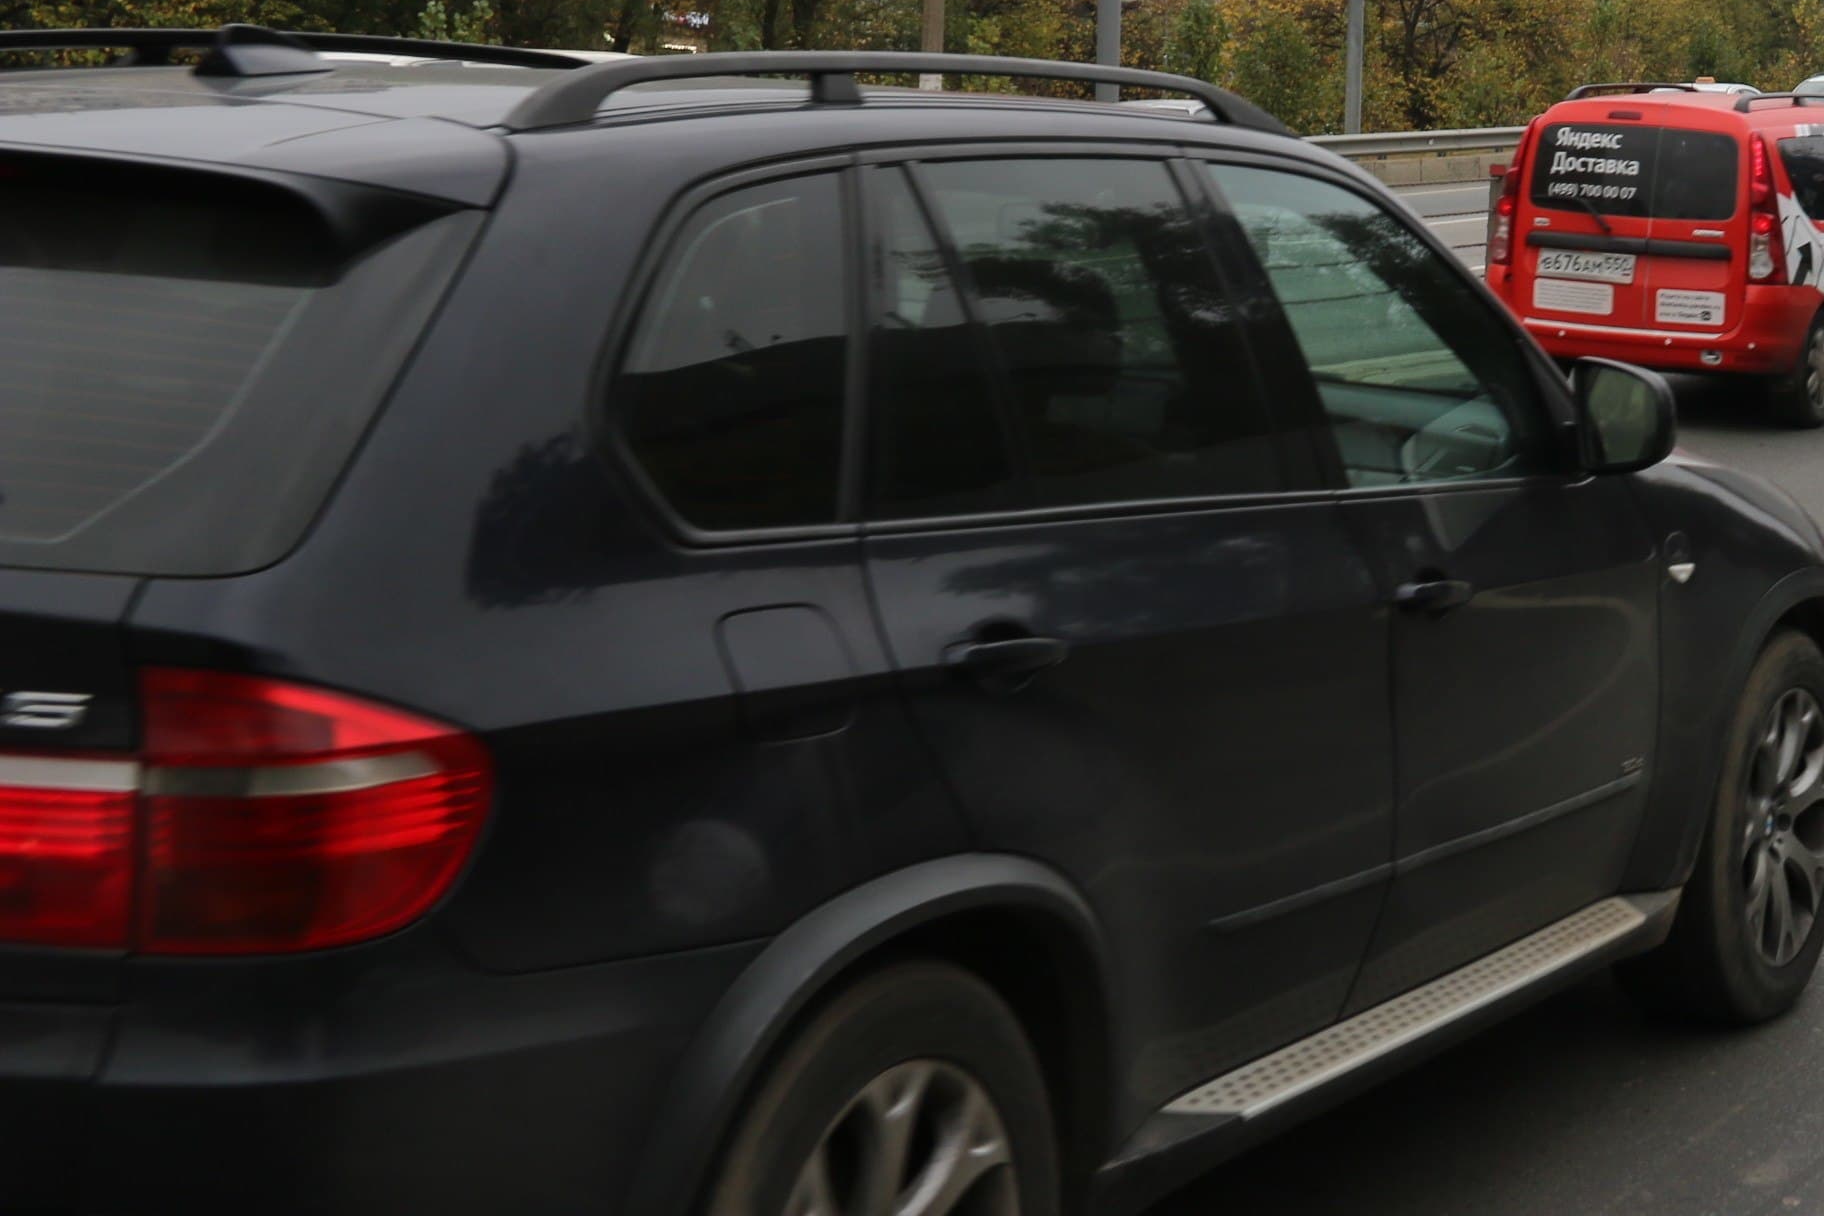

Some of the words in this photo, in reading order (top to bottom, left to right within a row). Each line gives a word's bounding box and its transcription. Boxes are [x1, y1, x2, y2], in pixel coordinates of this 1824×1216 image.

[1555, 126, 1624, 150] Яндекс
[1549, 151, 1640, 176] Доставка
[1547, 182, 1579, 198] (499)
